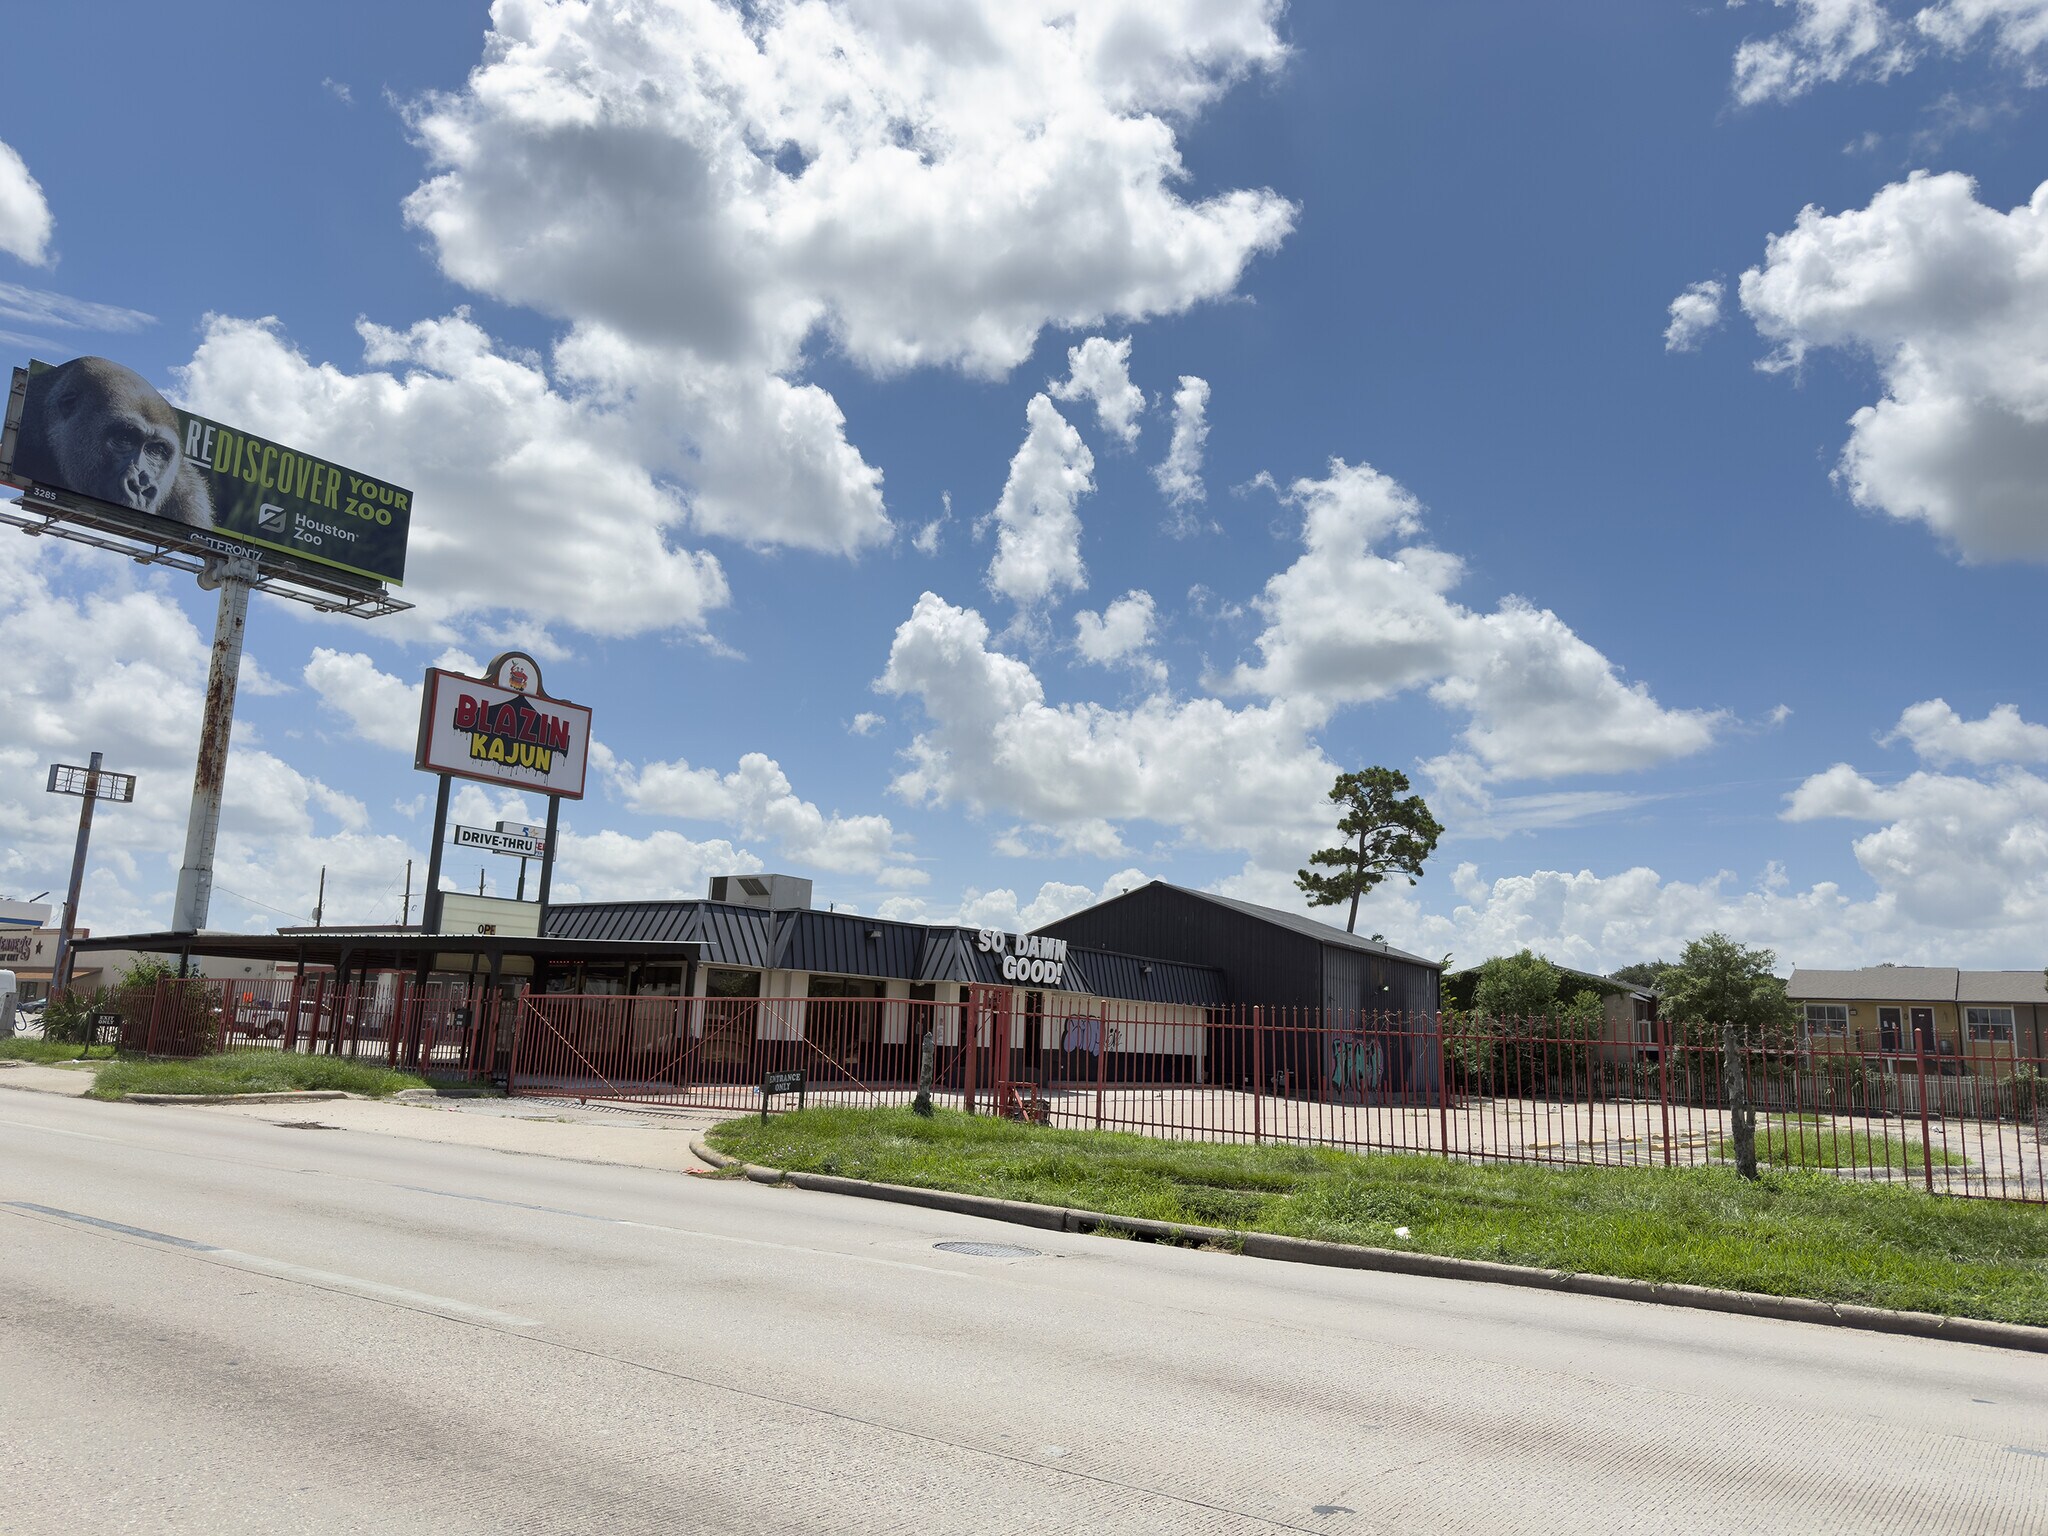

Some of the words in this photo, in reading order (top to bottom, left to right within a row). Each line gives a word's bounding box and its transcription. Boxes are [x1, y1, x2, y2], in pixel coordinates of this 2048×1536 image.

[185, 419, 341, 510] REDISCOVER
[33, 487, 57, 500] 3285
[349, 475, 408, 511] YOUR
[344, 497, 392, 526] ZOO
[293, 527, 323, 546] Zoo
[295, 513, 356, 542] Houston
[456, 694, 569, 750] BLAZIN
[471, 733, 551, 771] KAJUN
[462, 830, 533, 851] DRIVE-THRU
[978, 928, 1005, 953] SO
[1015, 933, 1067, 961] DAMN
[1002, 955, 1062, 984] GOOD!
[770, 1073, 801, 1083] ENTRANCE
[774, 1083, 791, 1091] ONLY
